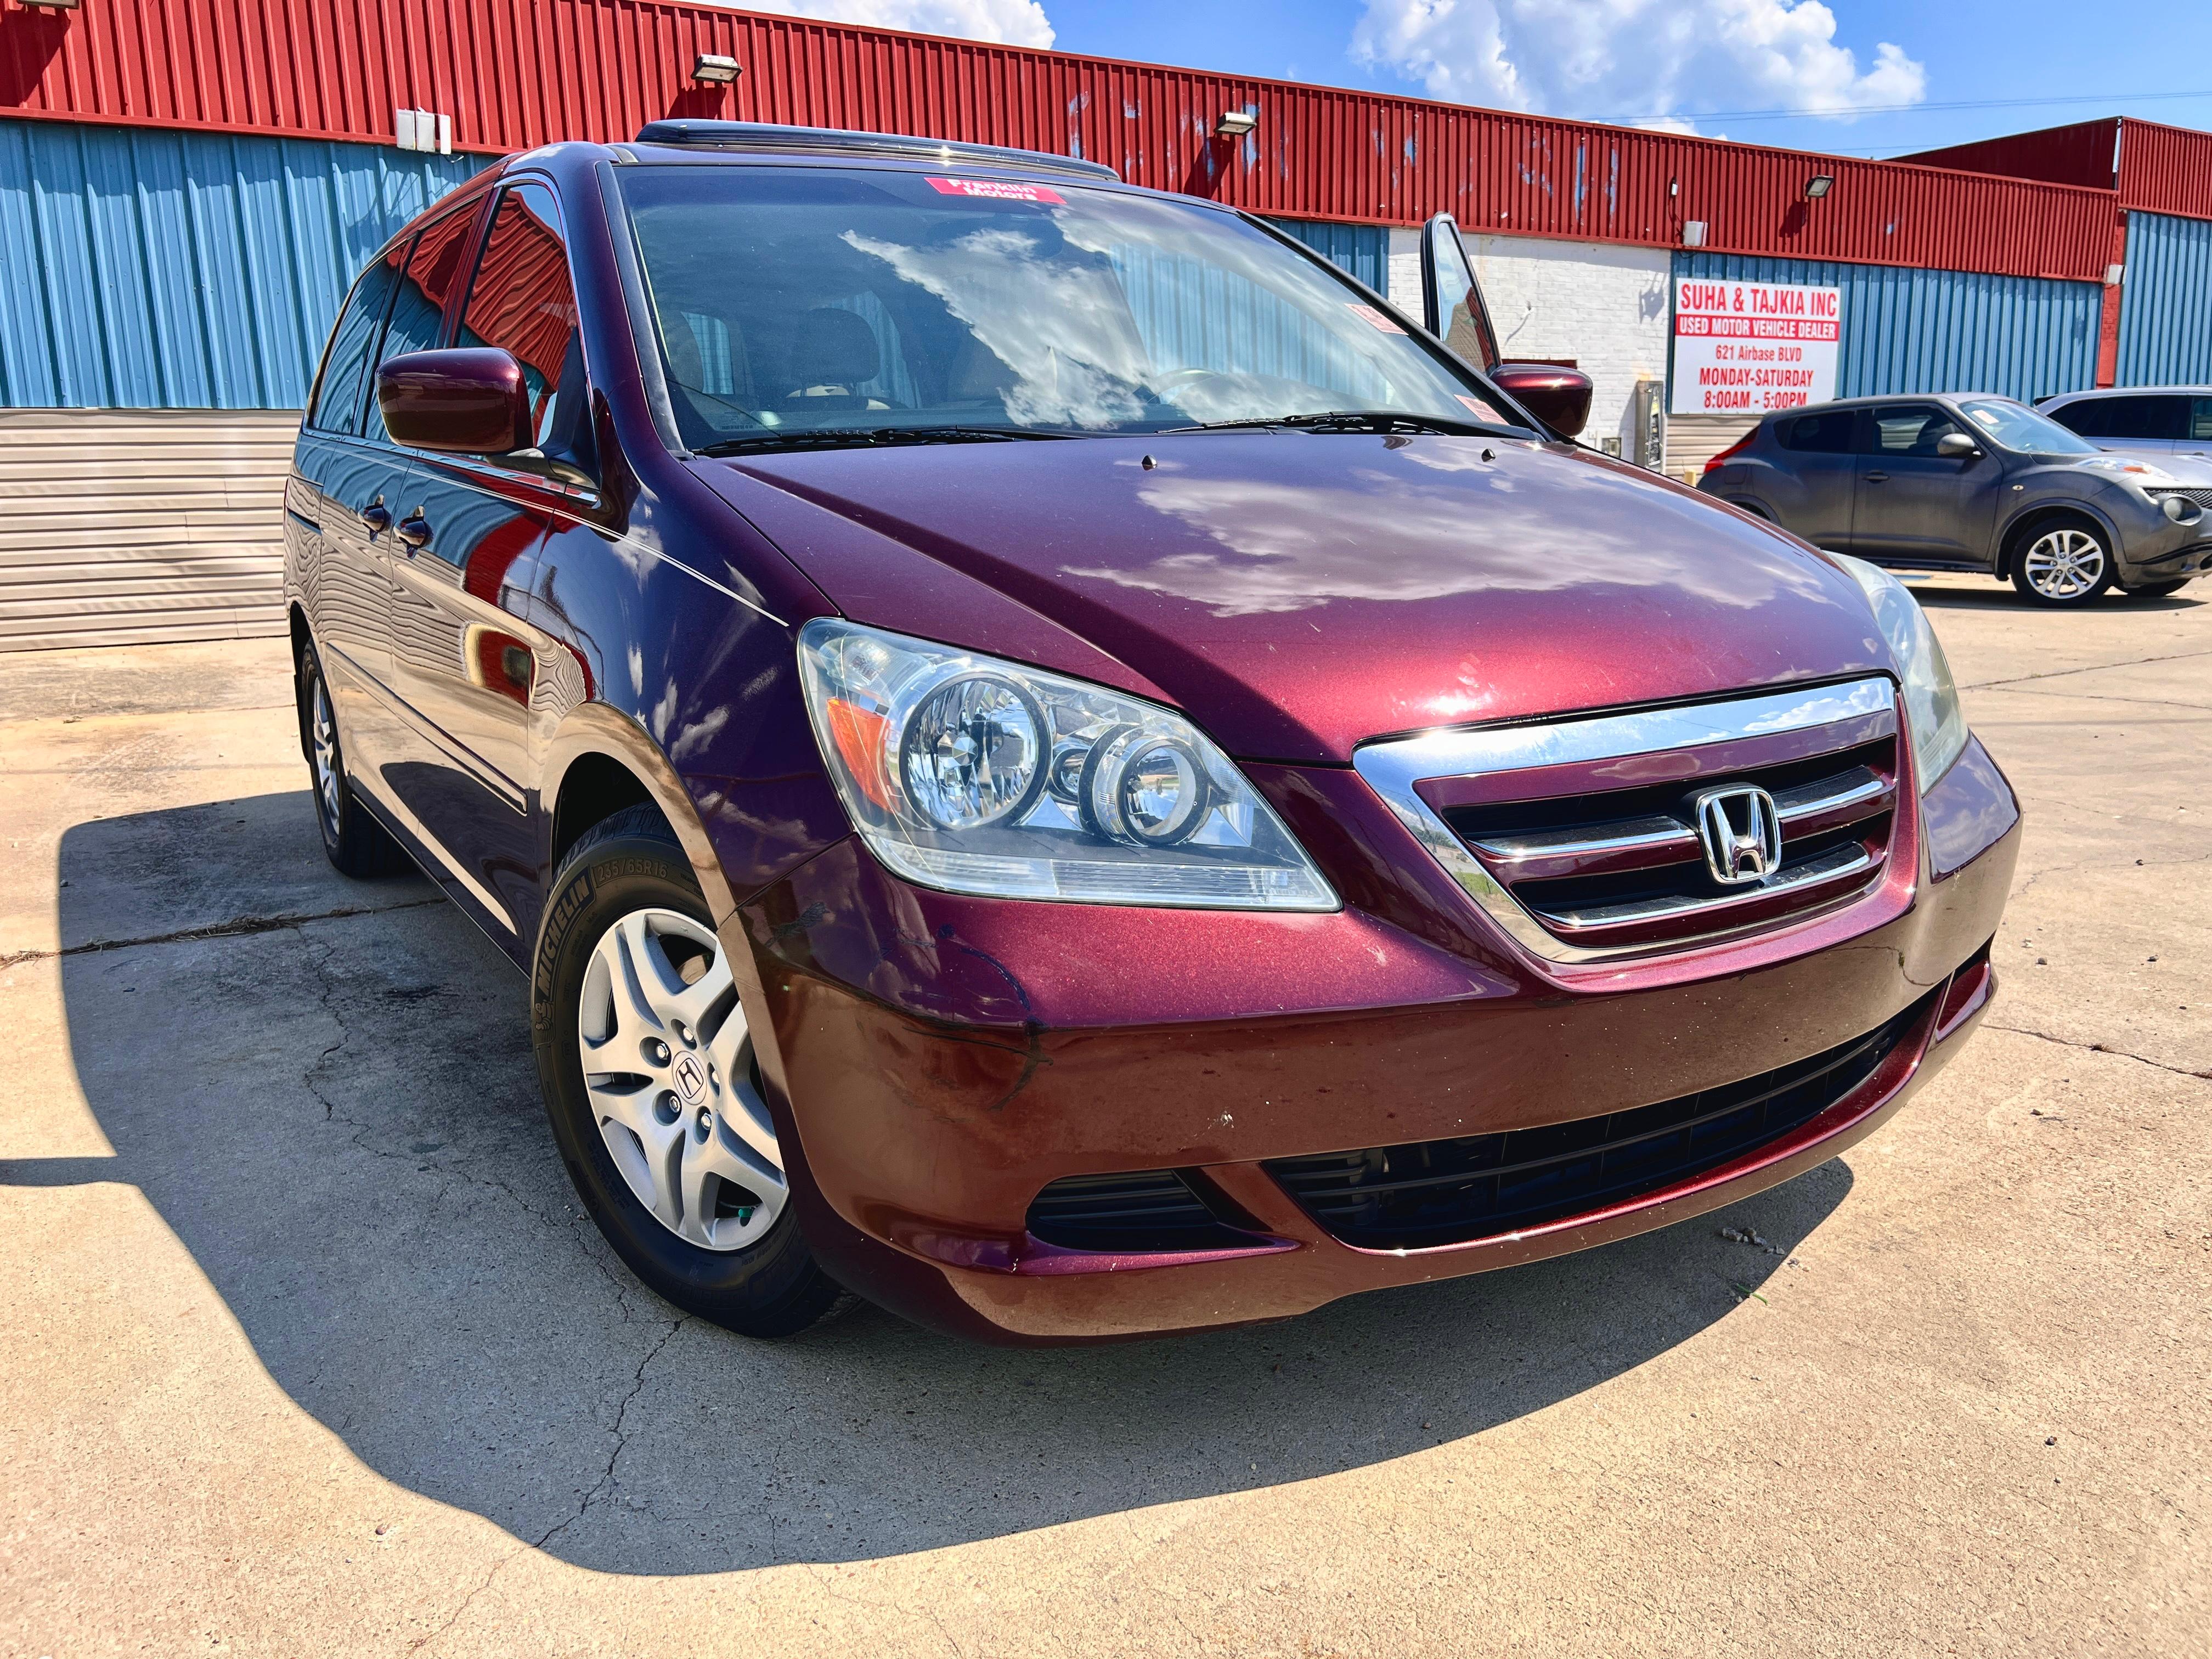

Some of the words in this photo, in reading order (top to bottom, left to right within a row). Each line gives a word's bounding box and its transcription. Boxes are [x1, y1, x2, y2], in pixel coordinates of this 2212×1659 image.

[947, 179, 1037, 193] Franklin
[963, 187, 1038, 200] Motors
[1681, 284, 1726, 311] SUHA
[1733, 287, 1746, 312] &
[1751, 289, 1805, 315] TAJKIA
[1810, 292, 1837, 317] INC
[1679, 317, 1709, 334] USED
[1711, 319, 1750, 336] MOTOR
[1753, 320, 1796, 338] VEHICLE
[1798, 322, 1835, 340] DEALER
[1716, 344, 1734, 360] 621
[1738, 345, 1774, 361] Airbase
[1779, 347, 1802, 362] BLVD
[1699, 368, 1814, 387] MONDAY-SATURDAY
[1703, 391, 1751, 408] 8:00AM
[1763, 392, 1807, 409] 5:00PM
[598, 859, 668, 880] 235/65R16
[538, 875, 591, 994] MICHELIN
